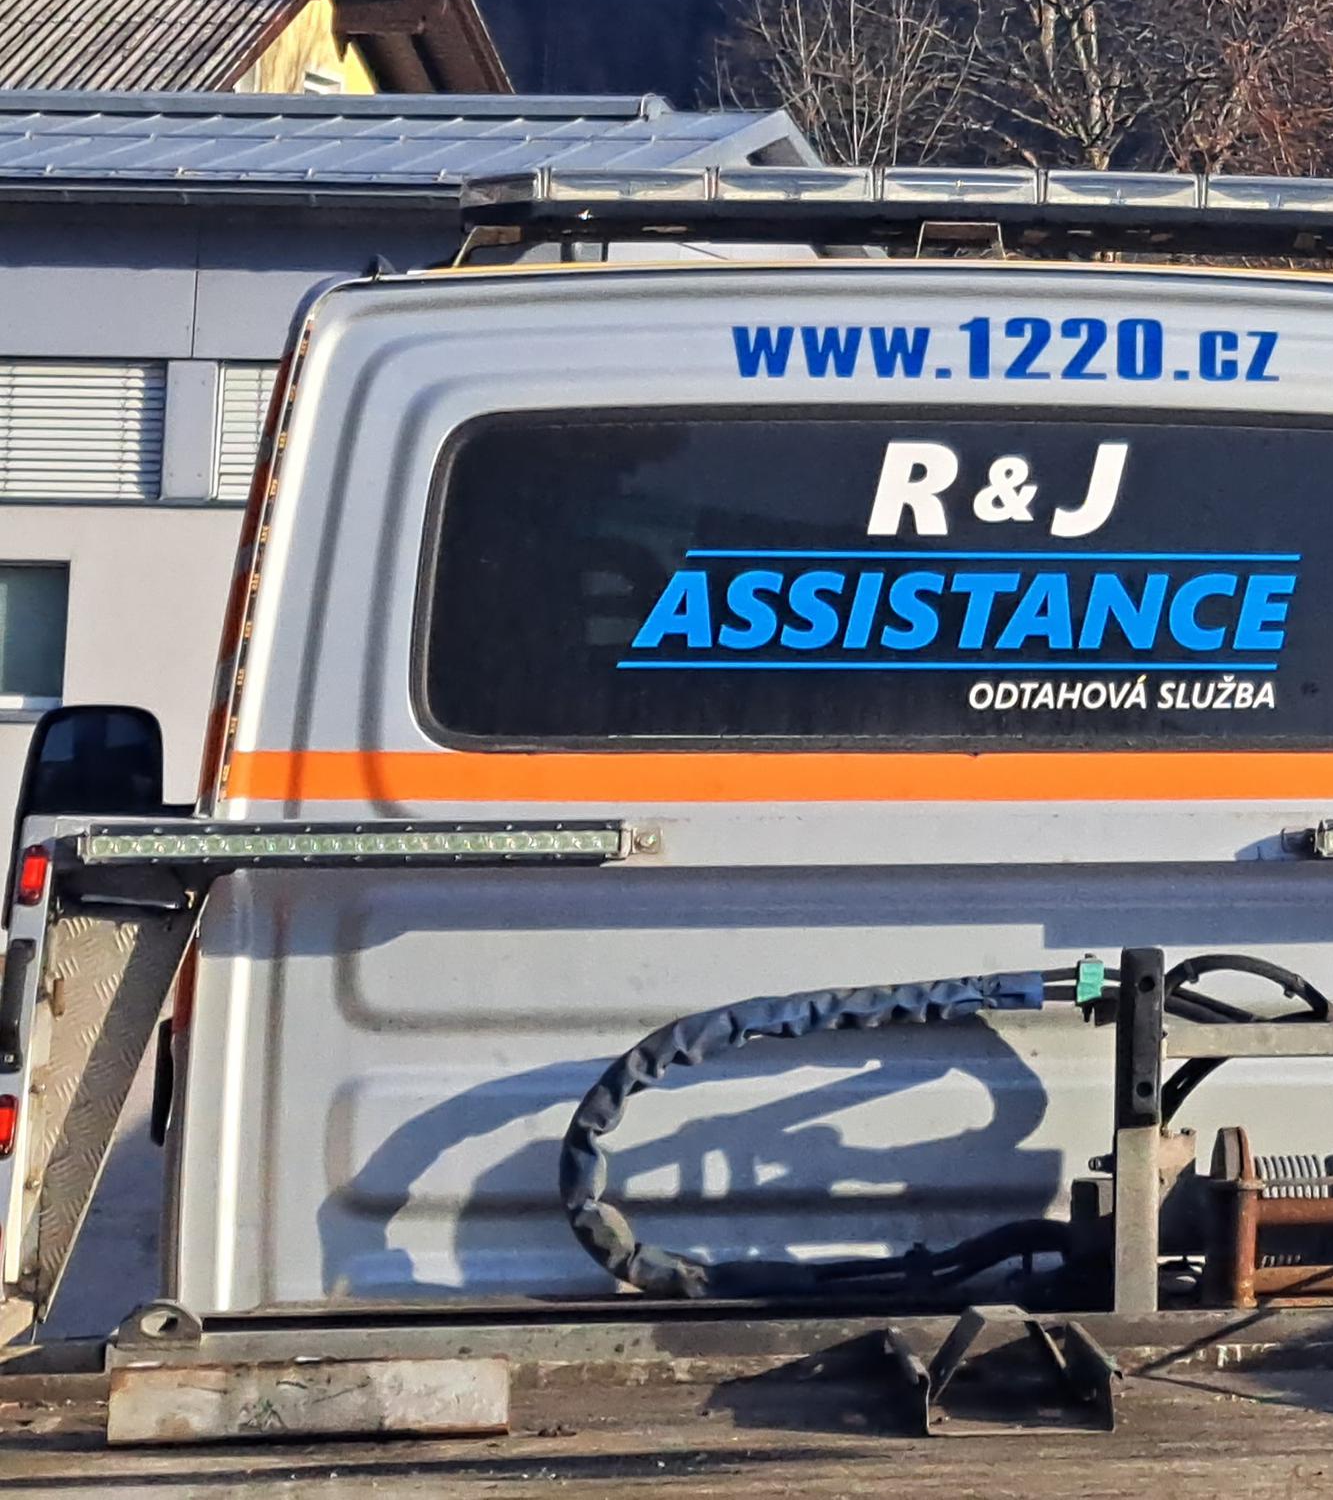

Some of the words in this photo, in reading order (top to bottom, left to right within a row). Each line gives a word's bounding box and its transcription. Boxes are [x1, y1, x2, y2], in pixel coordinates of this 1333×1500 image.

[866, 440, 959, 536] R
[972, 454, 1039, 523] &
[1050, 442, 1129, 538] J
[631, 569, 1298, 651] ASSISTANCE
[968, 673, 1148, 710] ODTAHOVÁ
[1156, 674, 1275, 710] SLUŽBA
